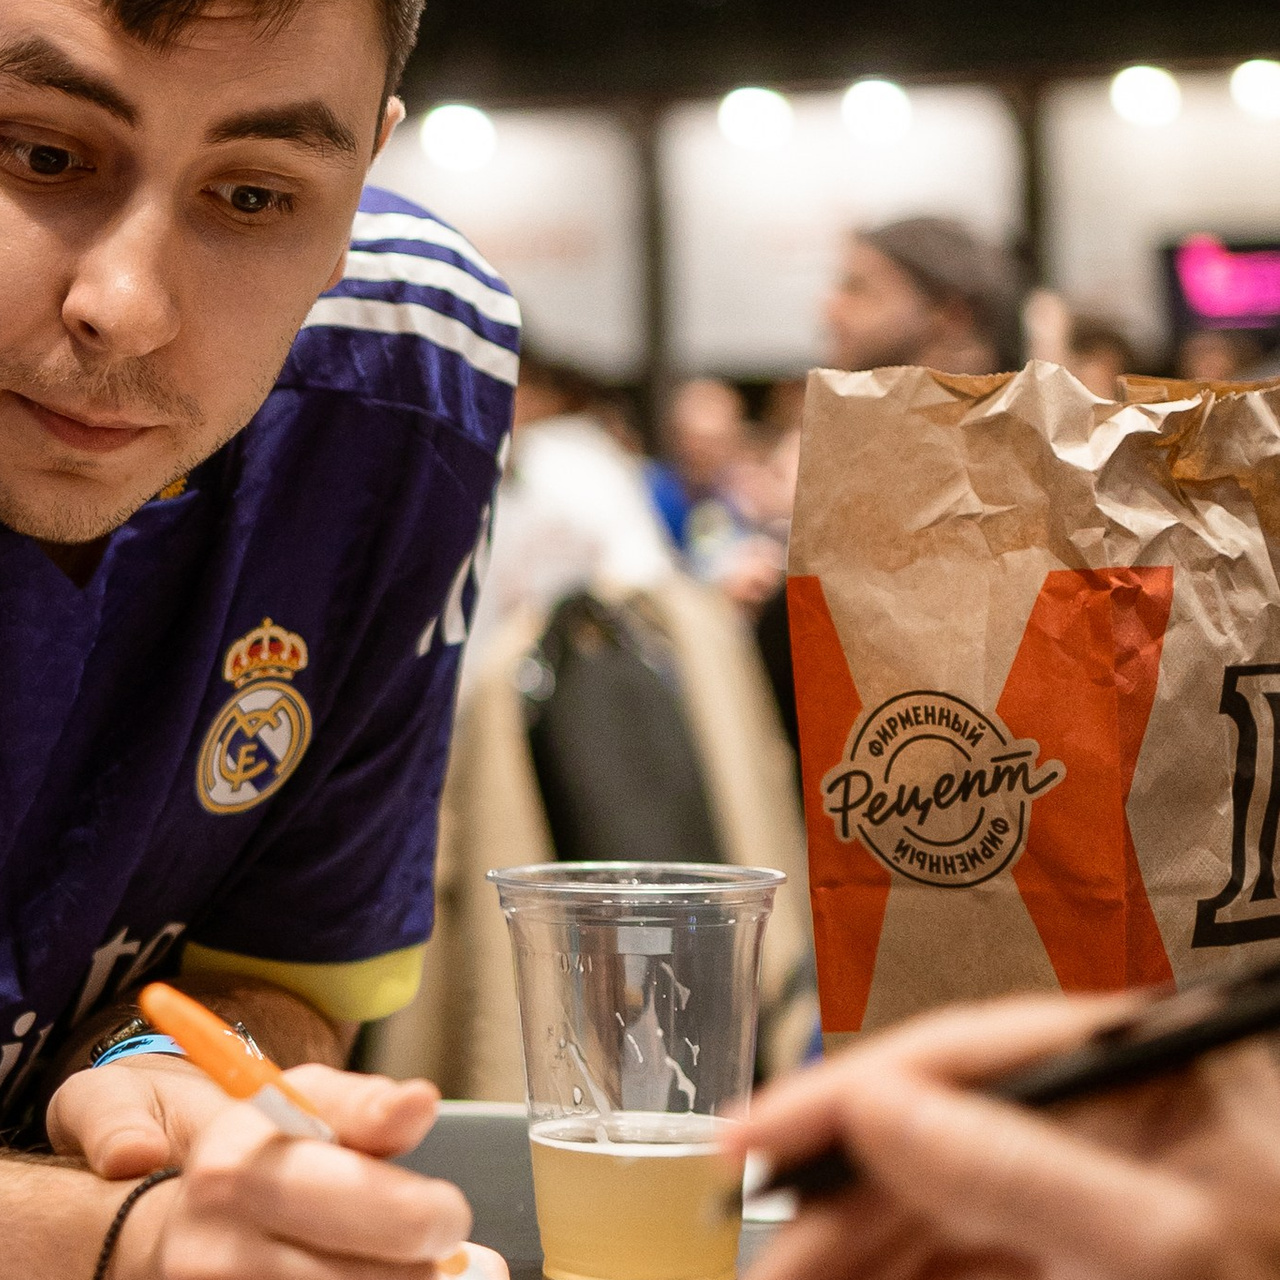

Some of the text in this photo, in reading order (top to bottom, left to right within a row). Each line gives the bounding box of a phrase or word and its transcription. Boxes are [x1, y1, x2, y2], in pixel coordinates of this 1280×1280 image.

[869, 705, 987, 757] ФИРМЕННЫЙ
[827, 750, 1058, 838] Рецепт
[893, 817, 1010, 875] ФИРМЕННЫЙ
